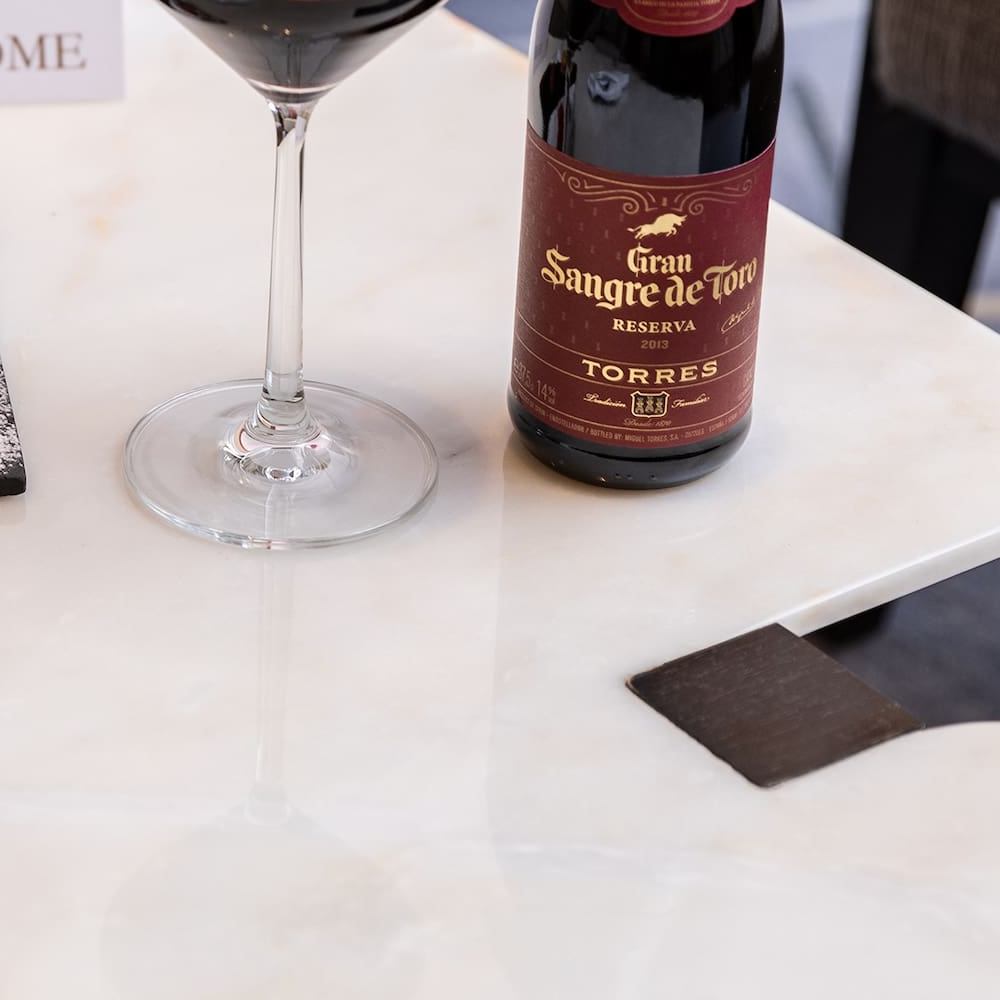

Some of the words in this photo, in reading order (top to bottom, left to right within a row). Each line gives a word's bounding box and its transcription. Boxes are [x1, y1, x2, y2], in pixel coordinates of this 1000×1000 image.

[627, 243, 692, 277] Gran
[541, 244, 660, 310] Sangre
[664, 275, 704, 307] de
[703, 257, 758, 305] Toro
[612, 318, 697, 334] RESERVA
[641, 339, 669, 350] 2013
[582, 359, 718, 384] TORRES
